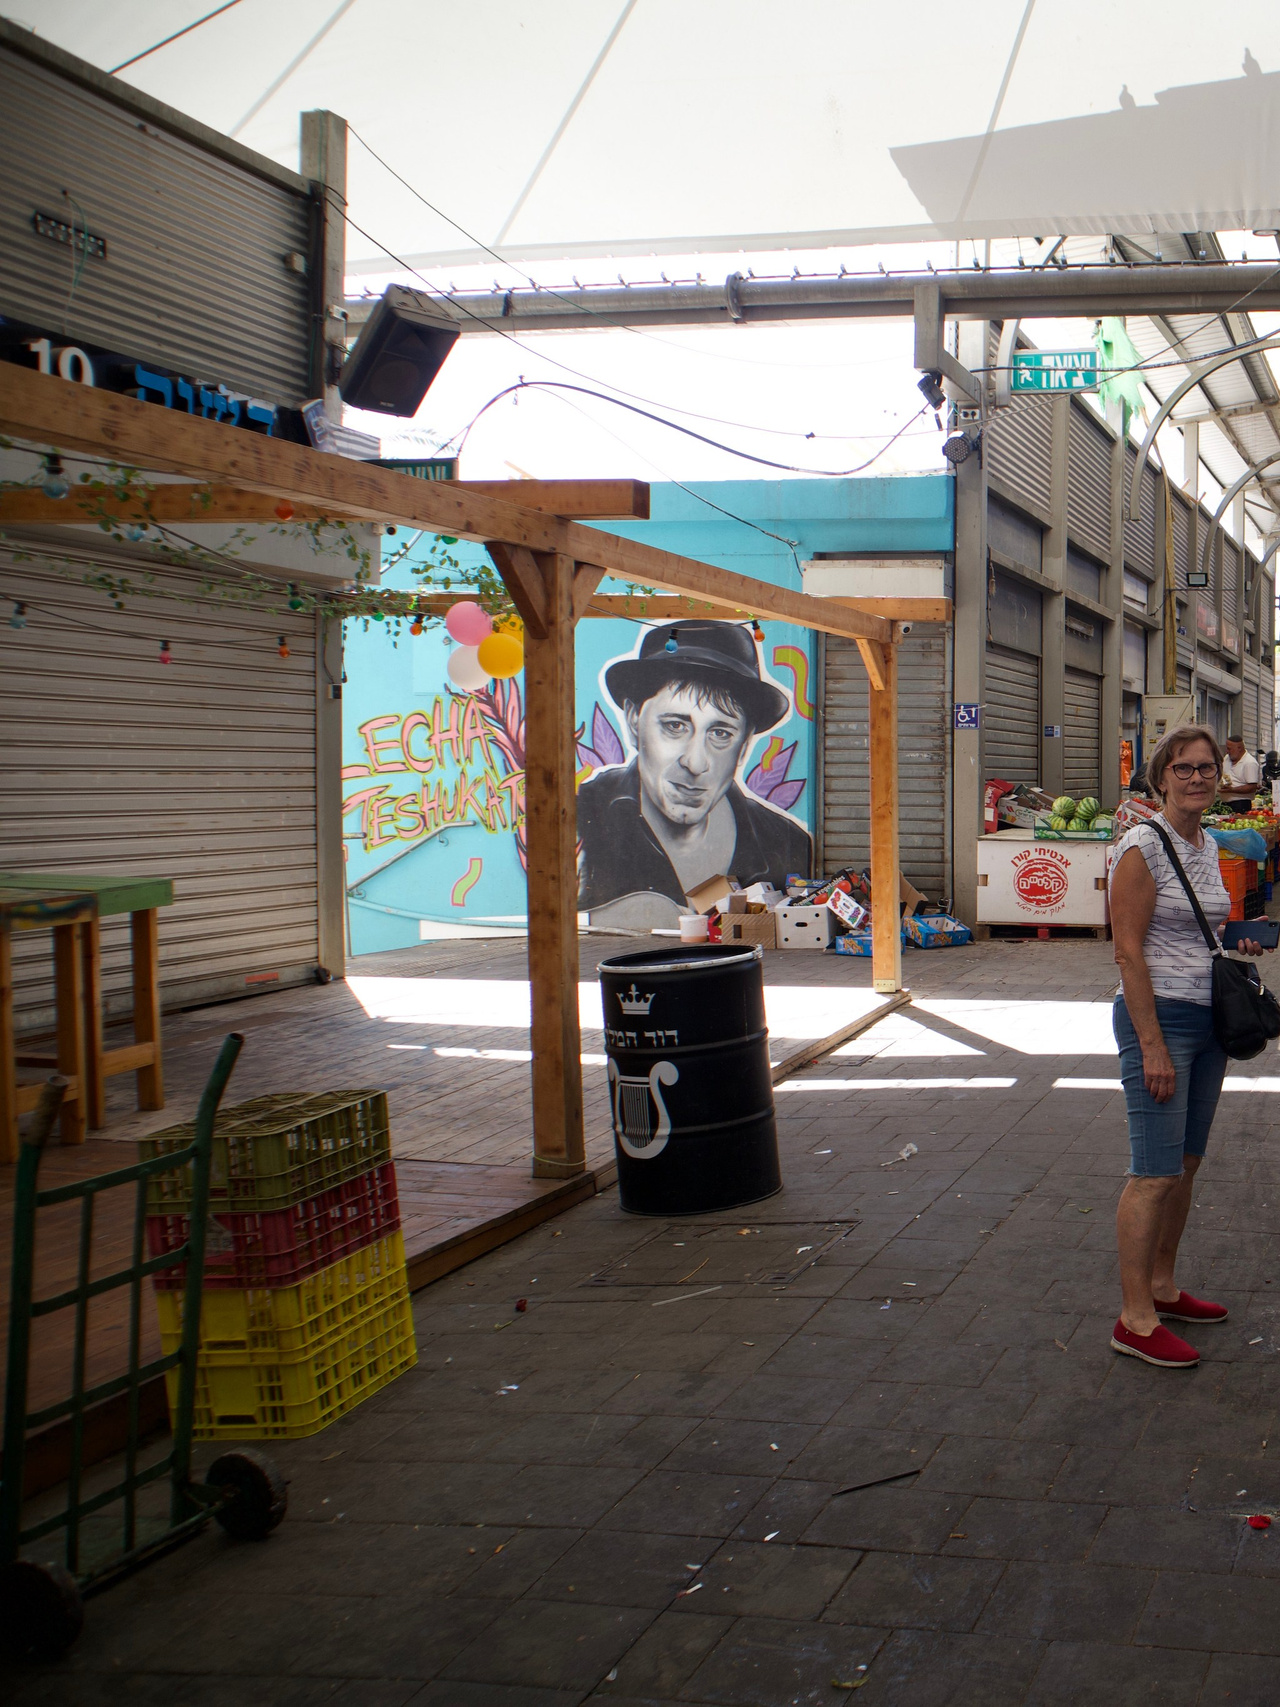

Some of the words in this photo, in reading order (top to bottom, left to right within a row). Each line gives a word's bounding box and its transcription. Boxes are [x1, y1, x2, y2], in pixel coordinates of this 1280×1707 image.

[1041, 354, 1091, 388] יציאה
[1010, 849, 1031, 868] קורן
[1034, 847, 1072, 869] אבטיחי
[817, 875, 846, 895] Vegetables
[643, 1029, 678, 1047] דוד
